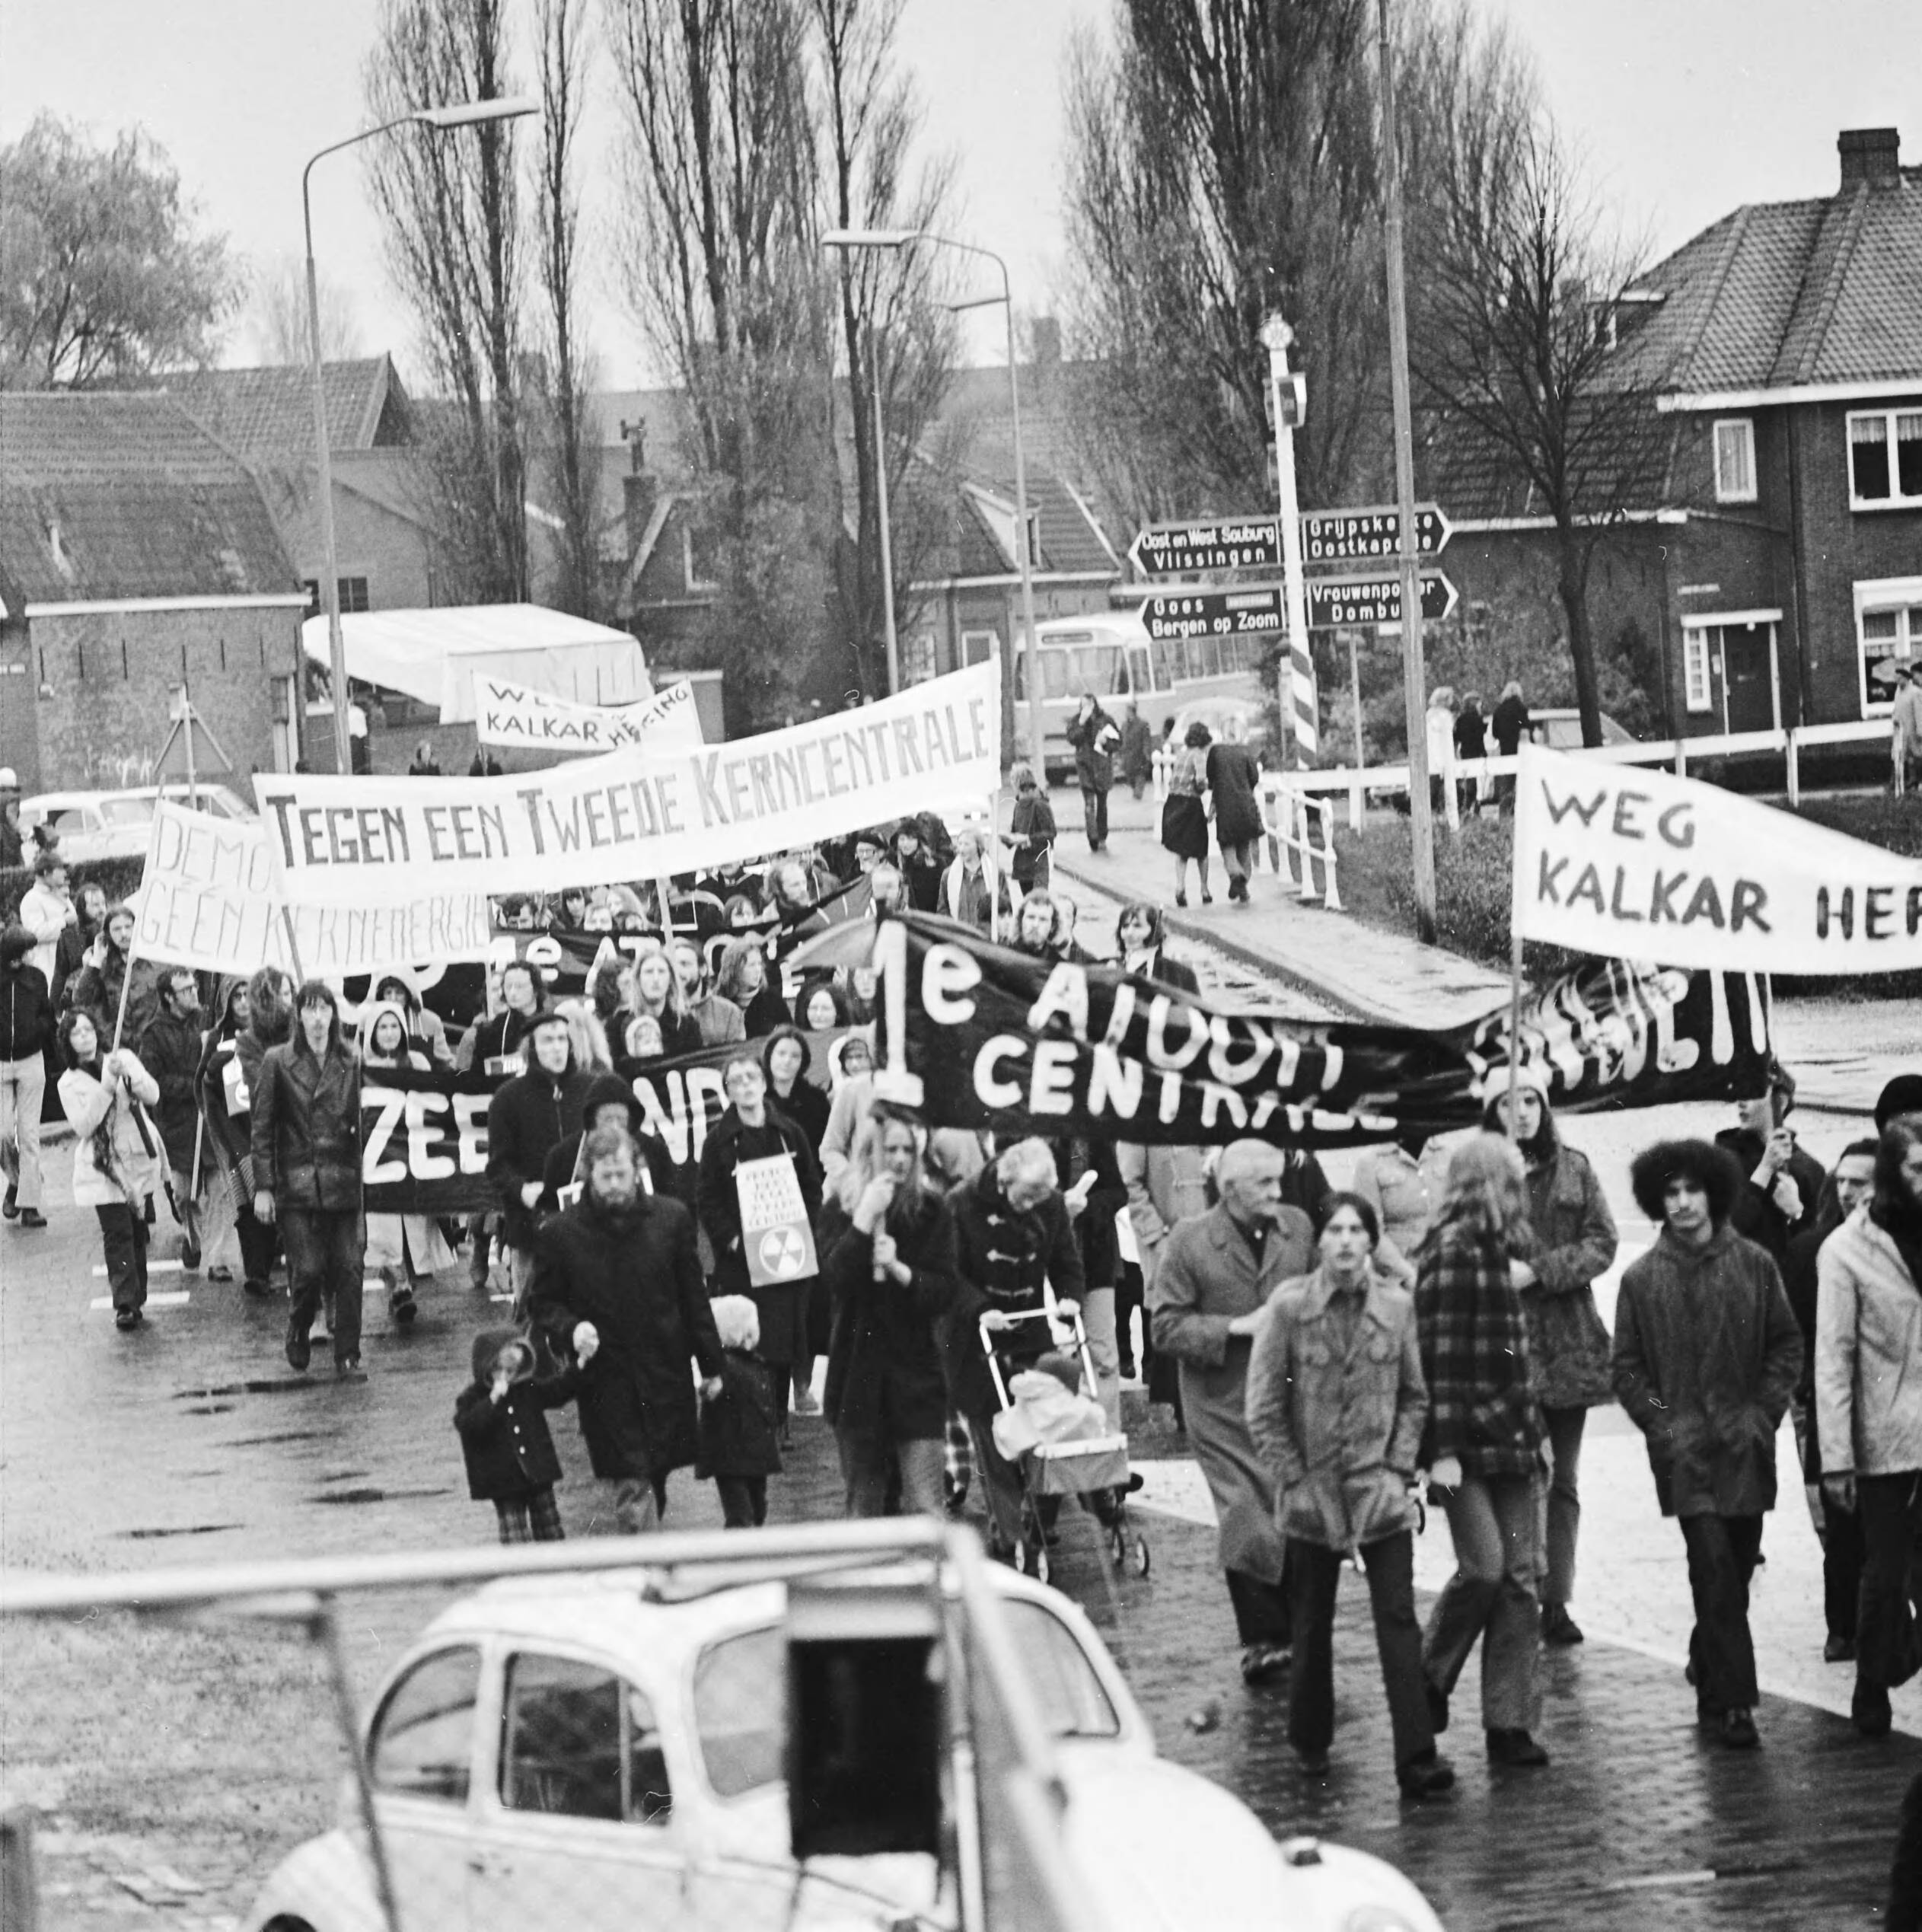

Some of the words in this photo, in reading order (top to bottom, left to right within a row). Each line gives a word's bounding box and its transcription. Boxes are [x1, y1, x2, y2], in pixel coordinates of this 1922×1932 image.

[1143, 531, 1170, 550] Oost
[1173, 534, 1187, 548] en
[1188, 528, 1217, 547] West
[1222, 524, 1275, 544] Souburg
[1153, 547, 1265, 569] Vlissingen
[1154, 598, 1203, 616] Goes
[1152, 617, 1207, 639] Bergen
[1214, 617, 1232, 634] op
[1237, 611, 1279, 630] Zoom
[487, 712, 599, 743] KALKAR
[266, 795, 411, 869] TEGEN
[423, 805, 510, 859] EEN
[517, 773, 687, 856] TWEEDE
[690, 698, 990, 828] KERNCENTRALE
[1541, 779, 1697, 850] WEG
[1538, 849, 1773, 935] KALKAR
[140, 876, 245, 961] GEEN
